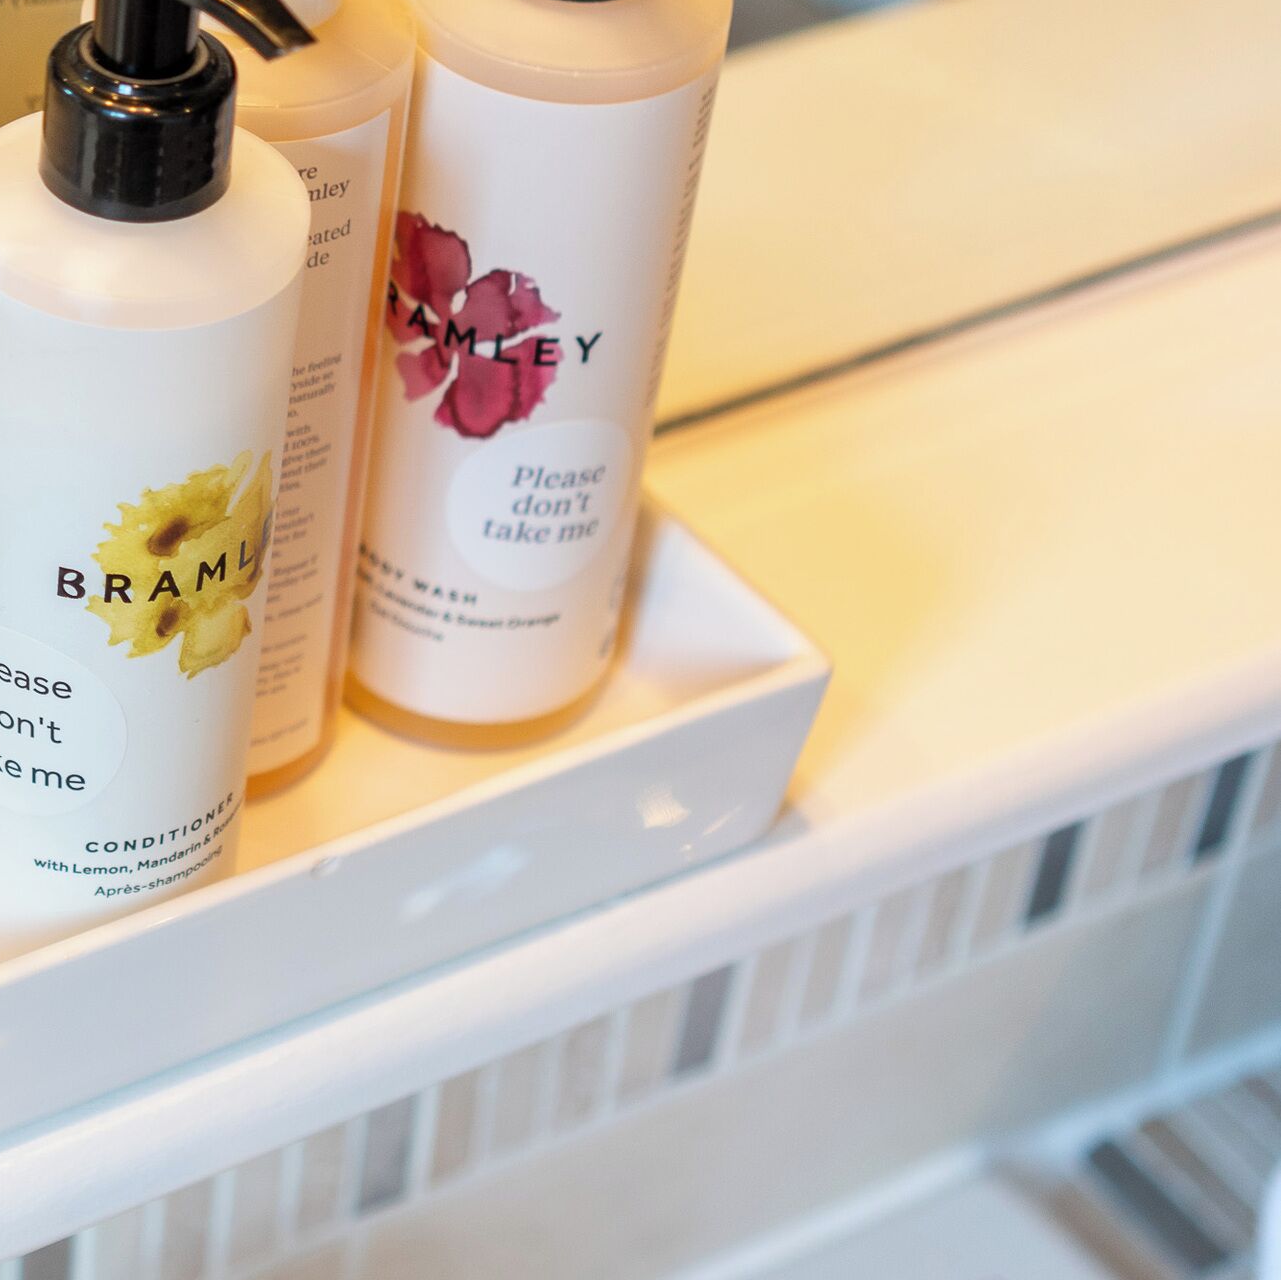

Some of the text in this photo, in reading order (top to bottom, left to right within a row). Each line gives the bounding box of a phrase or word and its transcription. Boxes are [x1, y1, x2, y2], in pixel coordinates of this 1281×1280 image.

[387, 280, 603, 368] RAMLEY
[512, 463, 607, 489] Please
[483, 518, 600, 544] take me
[412, 577, 478, 608] WASH
[32, 766, 86, 791] me
[85, 792, 234, 854] CONDITIONER
[33, 858, 69, 873] with
[72, 863, 134, 876] Lemon,
[136, 842, 202, 871] Mandarin
[203, 833, 211, 847] &
[94, 845, 223, 898] Après-shampooing
